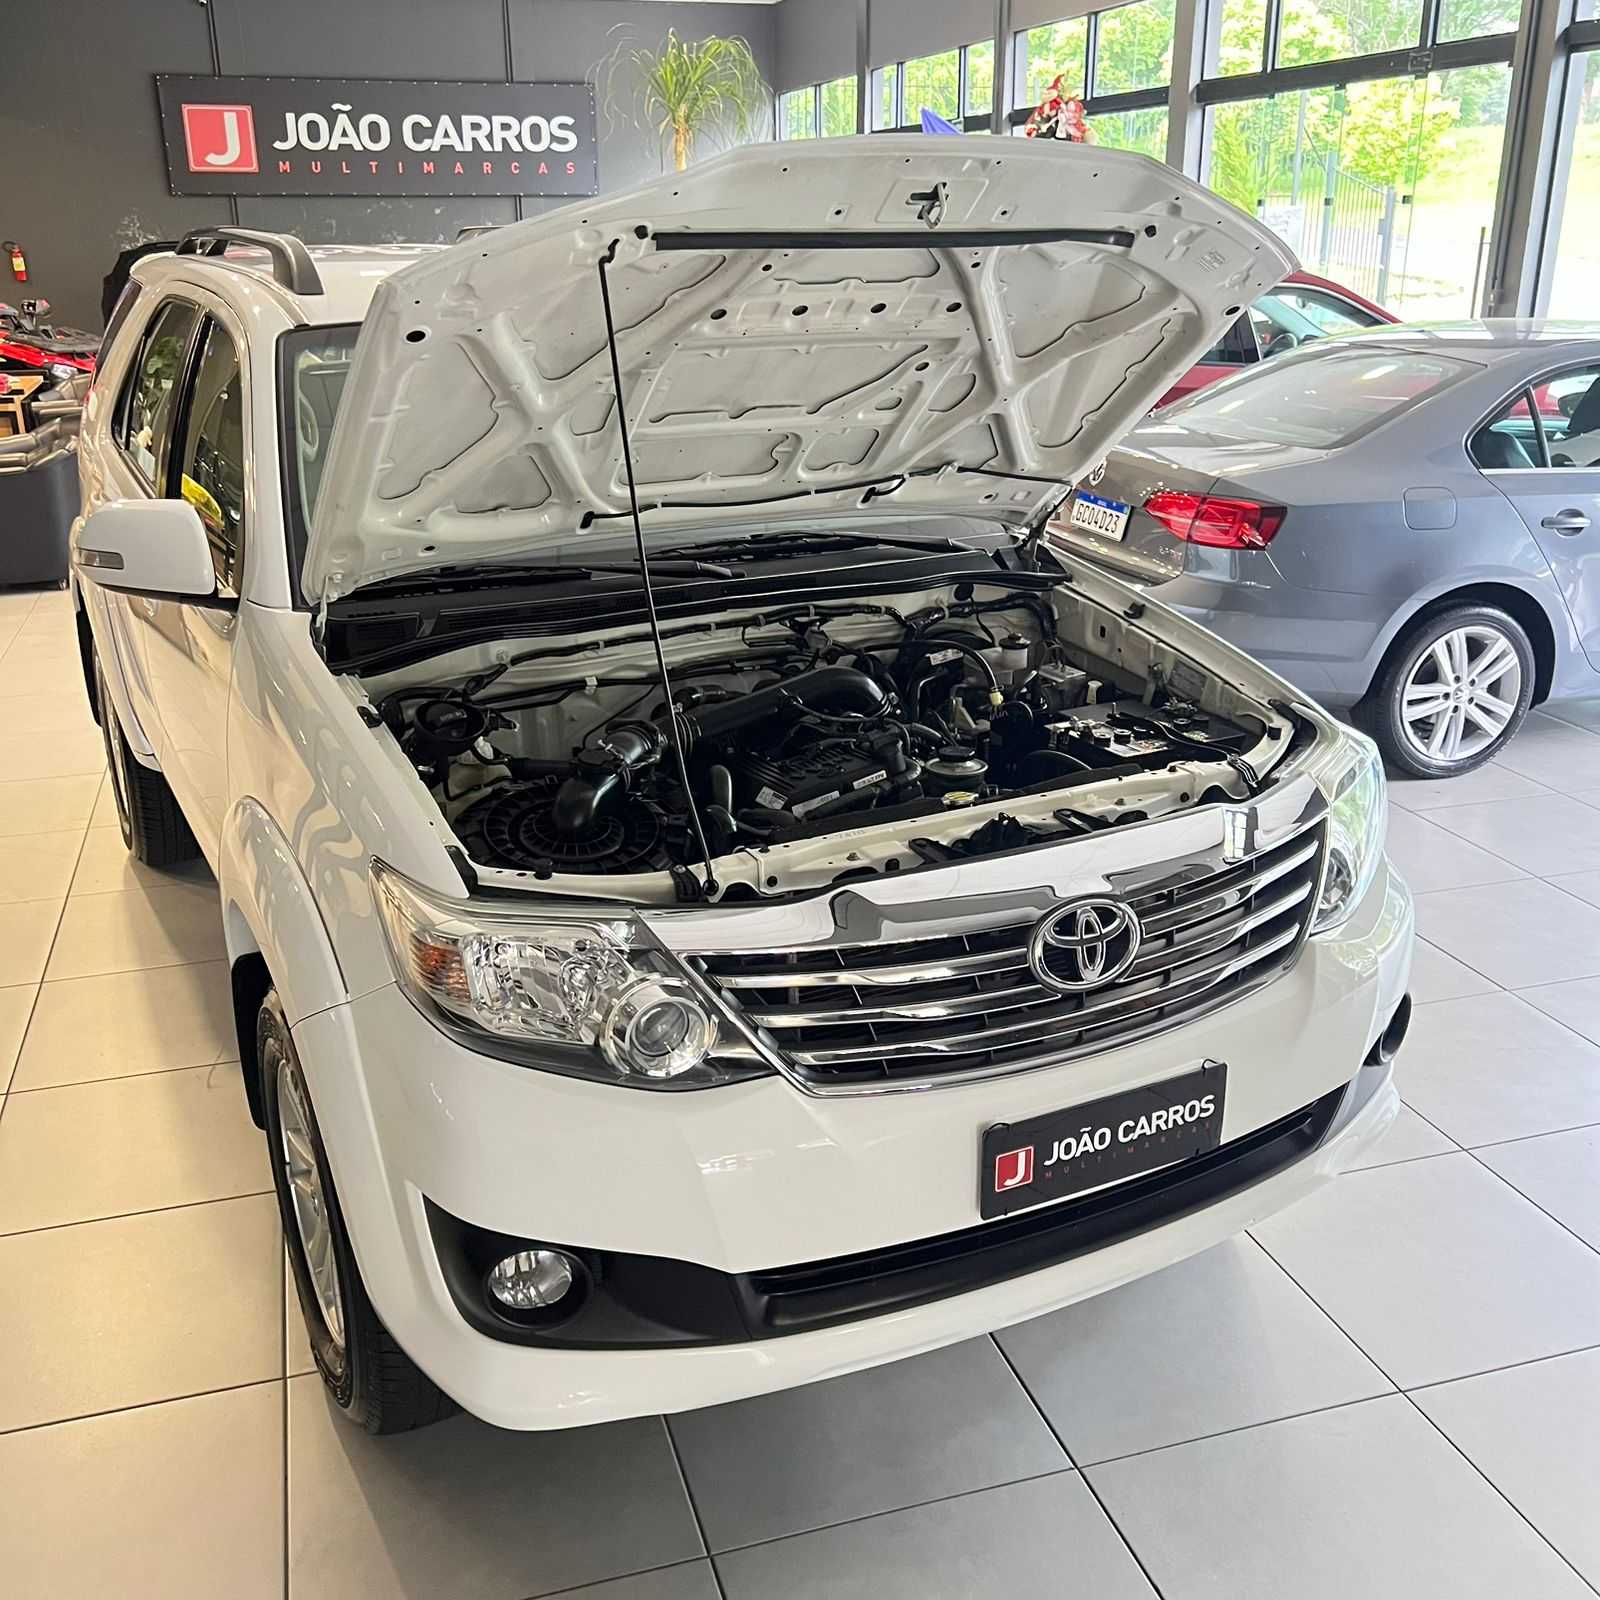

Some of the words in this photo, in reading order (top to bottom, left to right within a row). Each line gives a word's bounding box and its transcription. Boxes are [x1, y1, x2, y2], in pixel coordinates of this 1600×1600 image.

[204, 111, 240, 166] J
[273, 103, 391, 151] JOÃO
[402, 114, 578, 153] CARROS
[278, 160, 576, 175] MULTIMARCAS
[1043, 1126, 1112, 1166] JOÃO
[1117, 1094, 1216, 1142] CARROS
[1004, 1150, 1026, 1187] J
